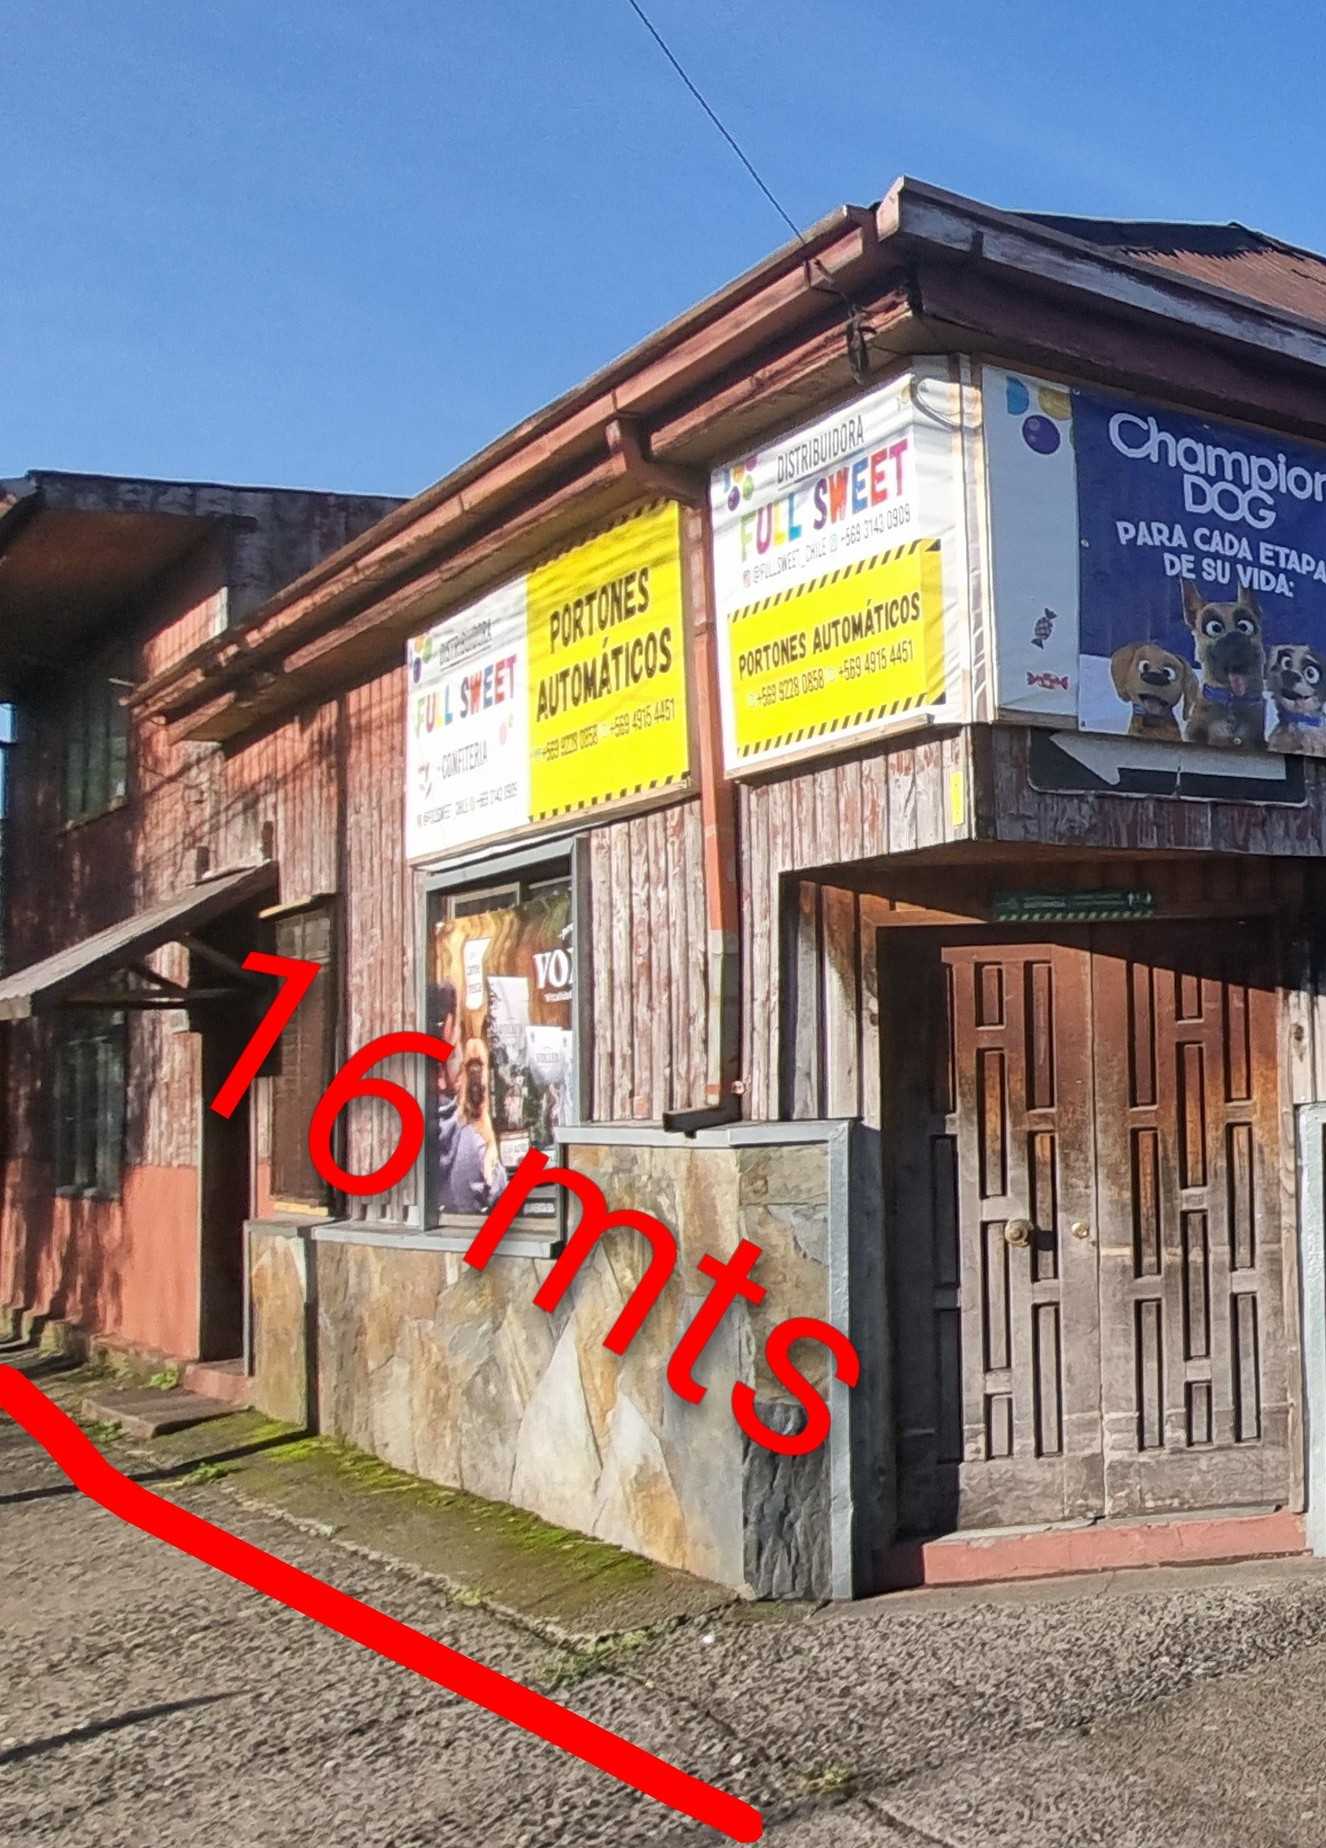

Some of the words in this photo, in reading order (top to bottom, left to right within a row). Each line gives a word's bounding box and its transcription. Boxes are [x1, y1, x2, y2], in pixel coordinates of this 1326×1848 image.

[777, 415, 864, 483] DISTRIBUIDORA
[740, 493, 802, 562] FULL
[813, 439, 908, 530] SWEET
[1184, 474, 1276, 529] DOG
[1116, 521, 1188, 548] PARA
[1193, 527, 1253, 561] CADA
[1163, 552, 1196, 580] DE
[1201, 558, 1230, 585] SU
[550, 567, 649, 654] PORTONES
[739, 632, 806, 680] PORTONES
[813, 592, 920, 654] AUTOMÁTICOS
[536, 627, 672, 722] AUTOMÁTICOS
[889, 640, 914, 666] 4451
[460, 655, 516, 719] SWEET
[533, 947, 574, 989] VO
